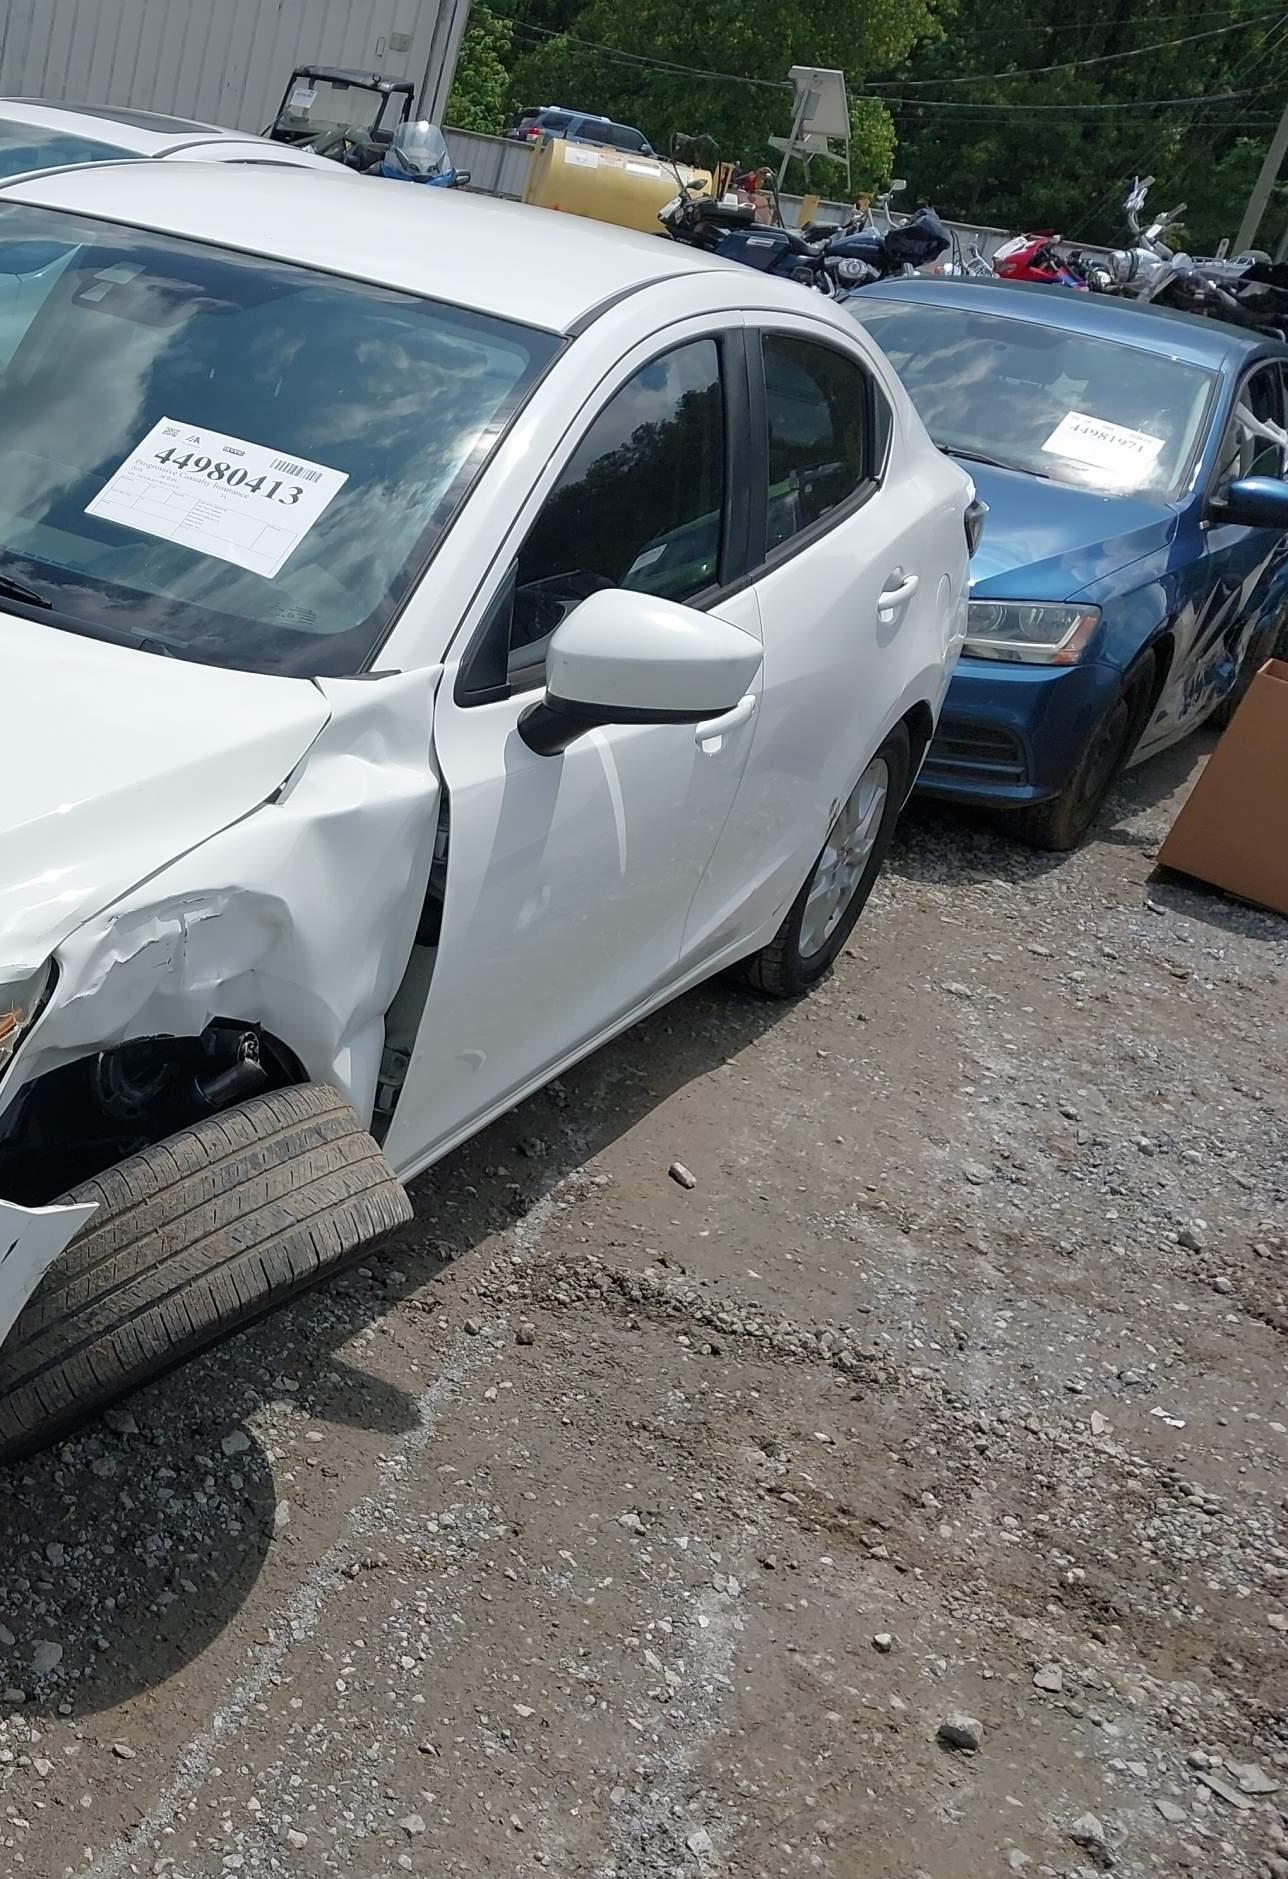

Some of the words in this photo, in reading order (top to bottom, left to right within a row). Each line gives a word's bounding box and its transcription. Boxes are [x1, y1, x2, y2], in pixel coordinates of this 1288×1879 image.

[1070, 424, 1144, 453] 44981971
[153, 447, 305, 507] 44980413
[213, 481, 250, 499] Insurance
